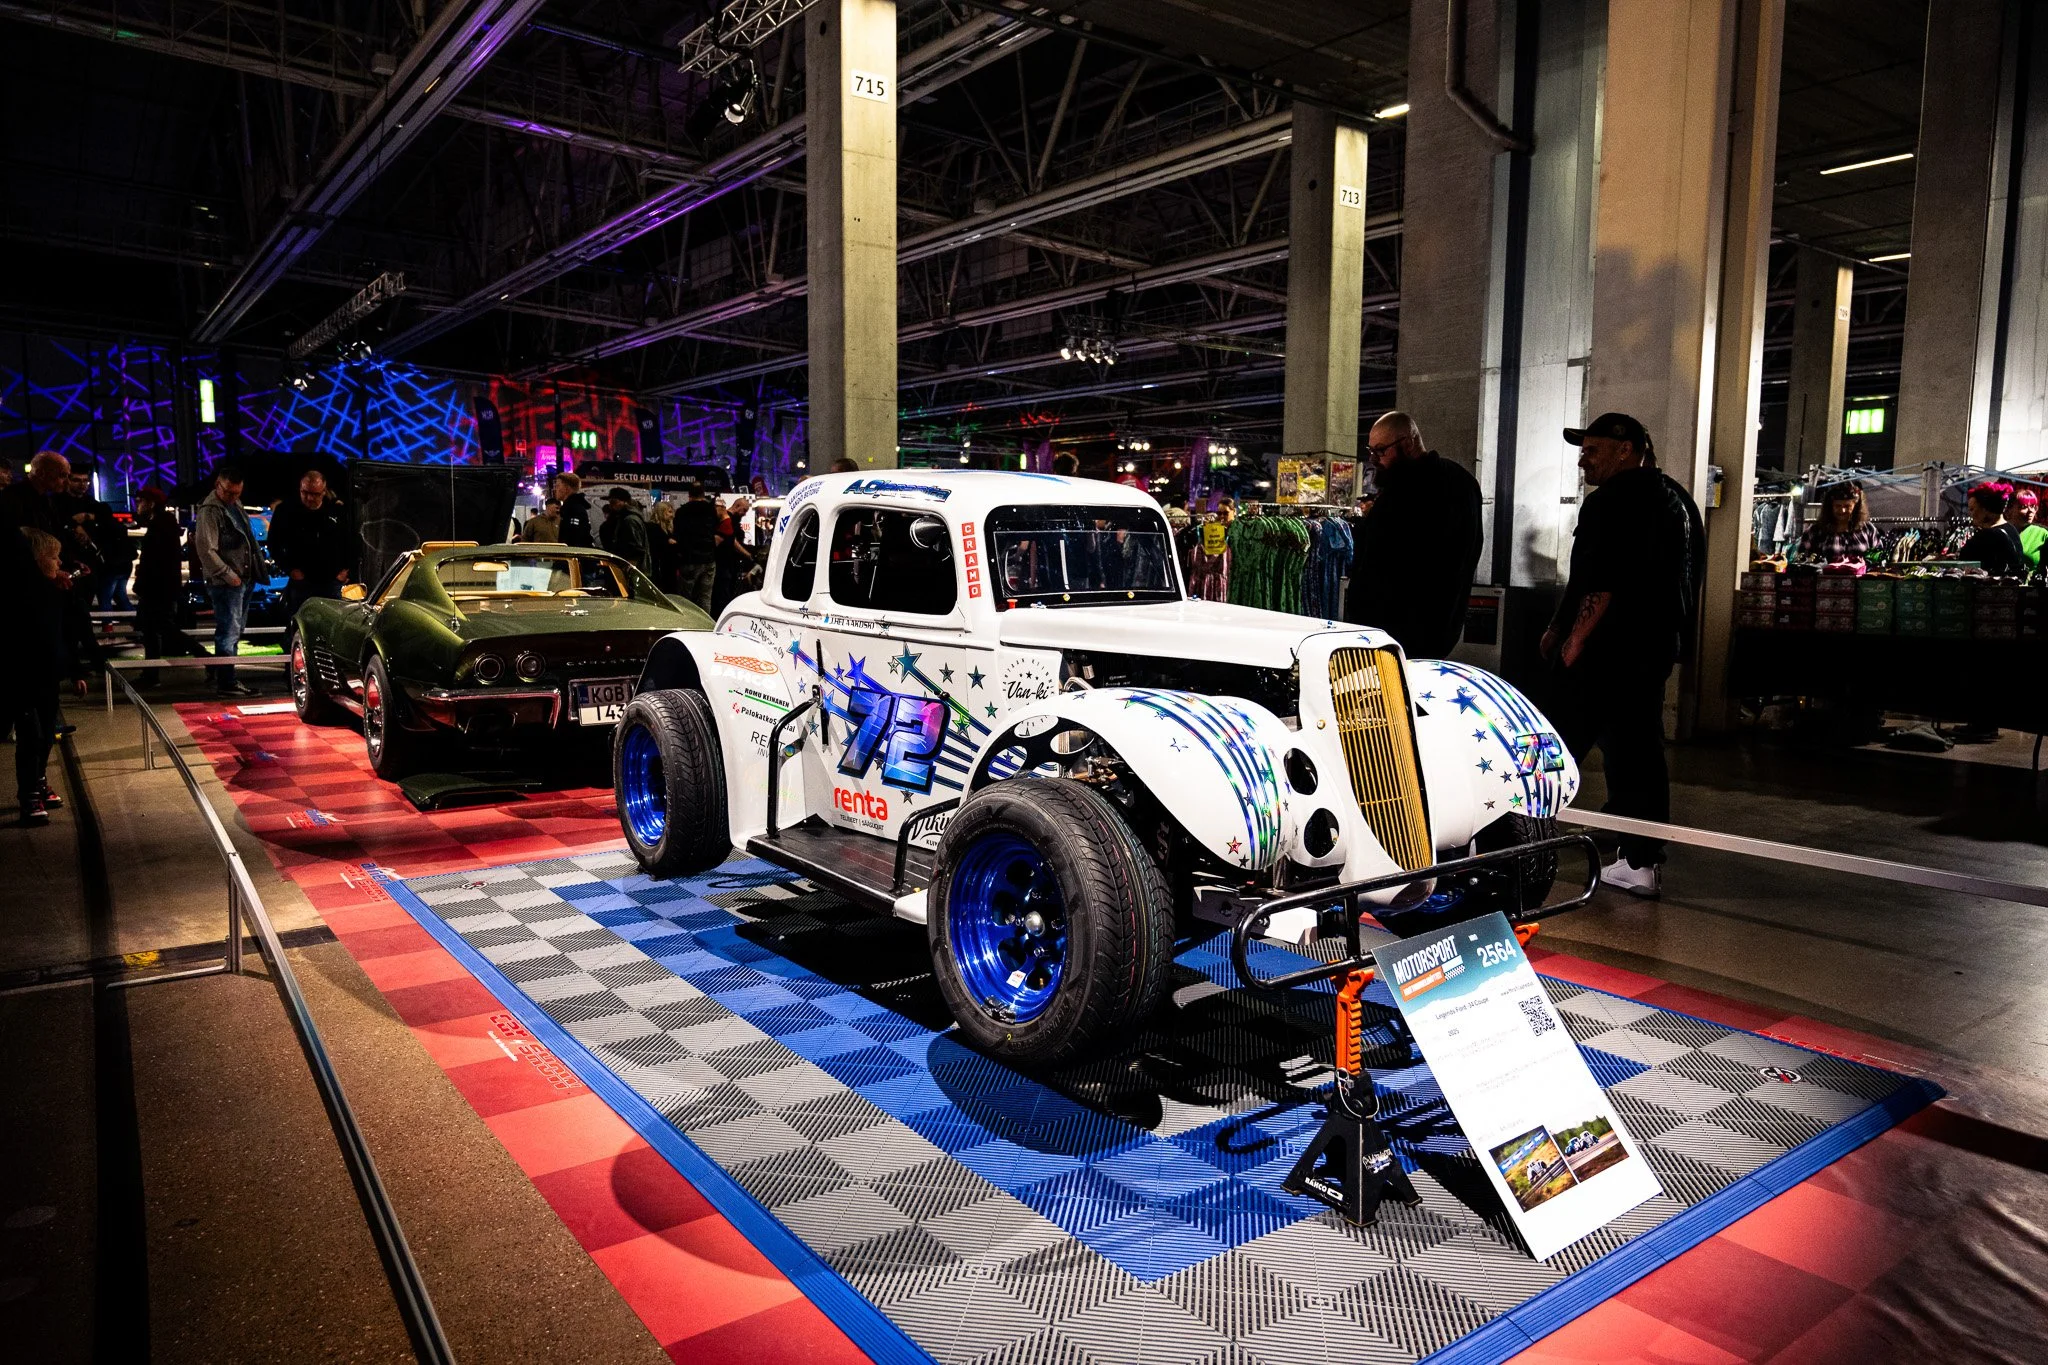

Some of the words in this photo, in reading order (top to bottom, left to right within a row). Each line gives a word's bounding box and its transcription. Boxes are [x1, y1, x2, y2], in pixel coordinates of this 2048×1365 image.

[855, 75, 885, 97] 715
[1342, 189, 1360, 205] 713
[613, 472, 639, 482] SECTO
[640, 473, 663, 483] RALLY
[664, 474, 697, 484] FINLAND
[962, 522, 980, 598] CRAMO
[591, 686, 625, 704] KOB
[744, 687, 762, 699] ROMU
[1007, 680, 1050, 700] Van-ki
[836, 684, 952, 797] 72
[1515, 732, 1565, 778] 72
[833, 787, 889, 821] renta
[1392, 935, 1459, 986] MOTORSPORT
[1476, 938, 1518, 968] 2564
[1304, 1176, 1328, 1193] BAHCO
